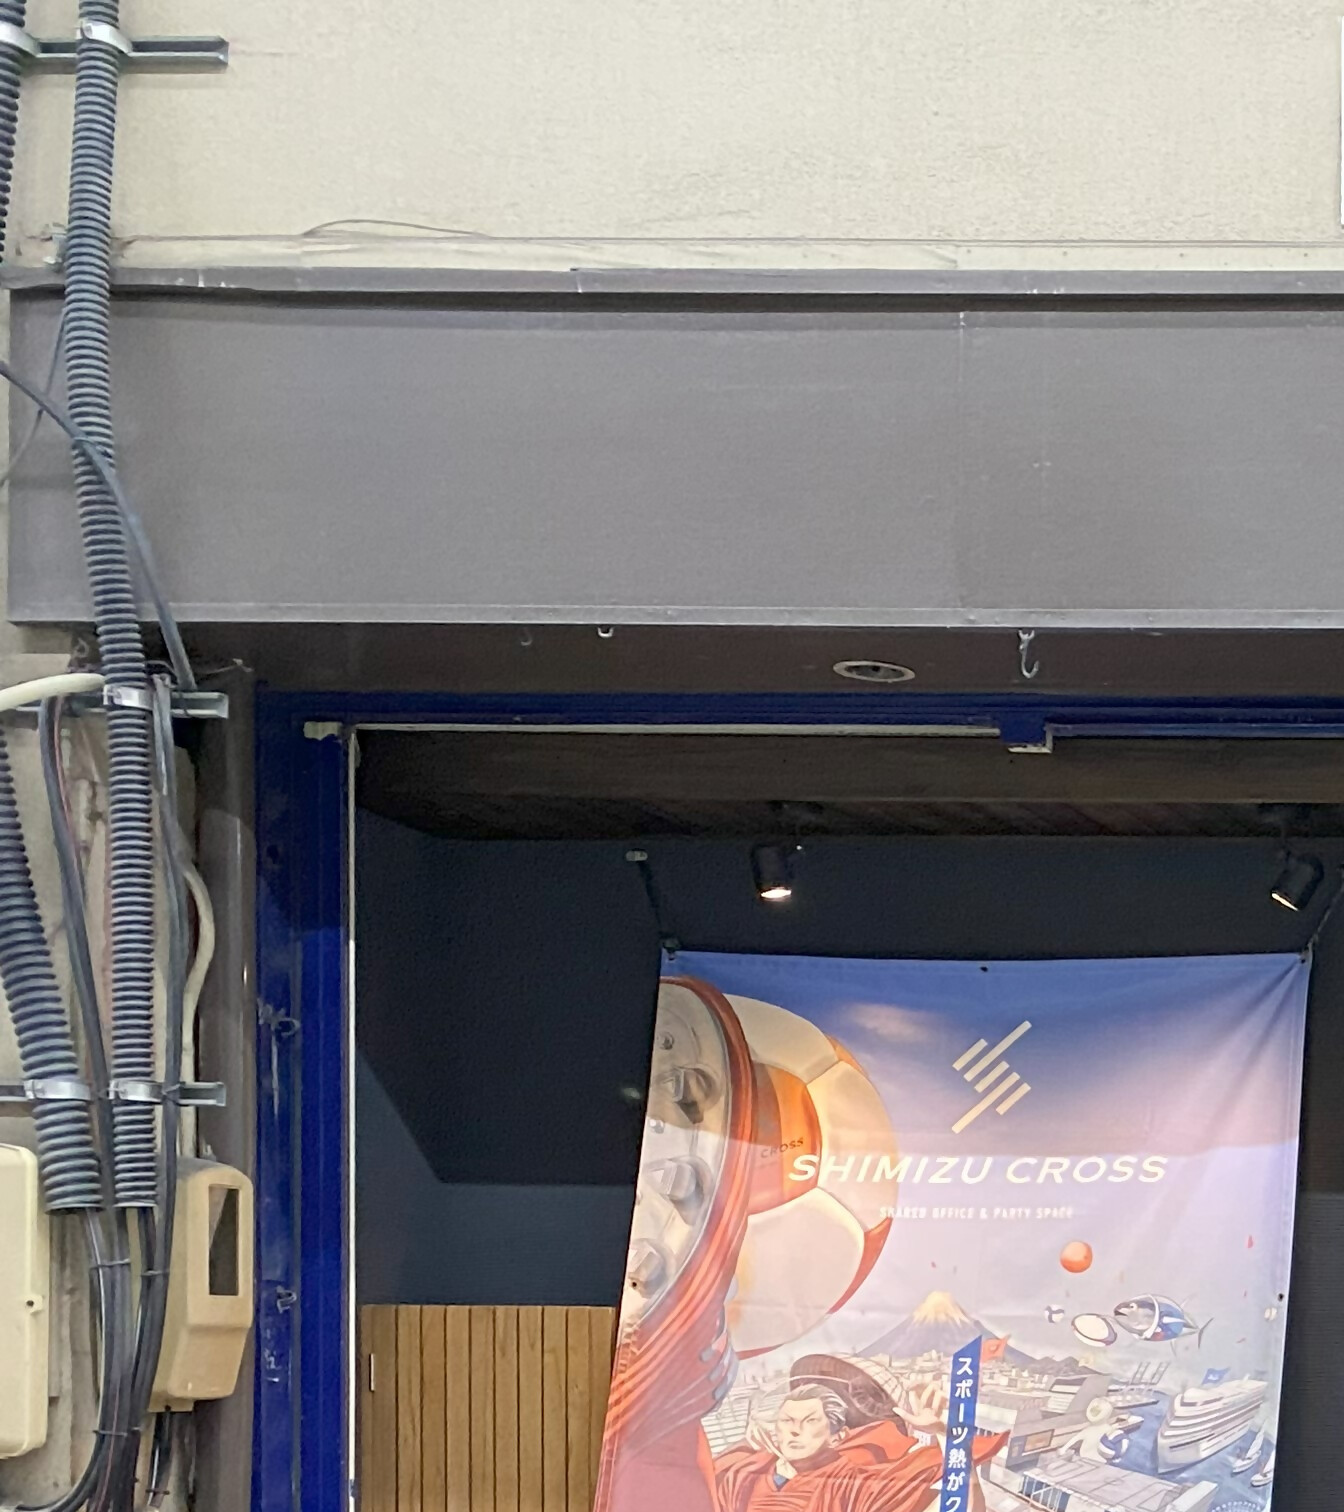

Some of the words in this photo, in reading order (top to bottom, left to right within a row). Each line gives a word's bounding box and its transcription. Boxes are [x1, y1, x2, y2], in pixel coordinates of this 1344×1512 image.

[760, 1137, 804, 1159] CROSS
[788, 1153, 992, 1185] SHIMIZU
[1005, 1154, 1169, 1185] CROSS
[993, 1207, 1031, 1220] PARTY
